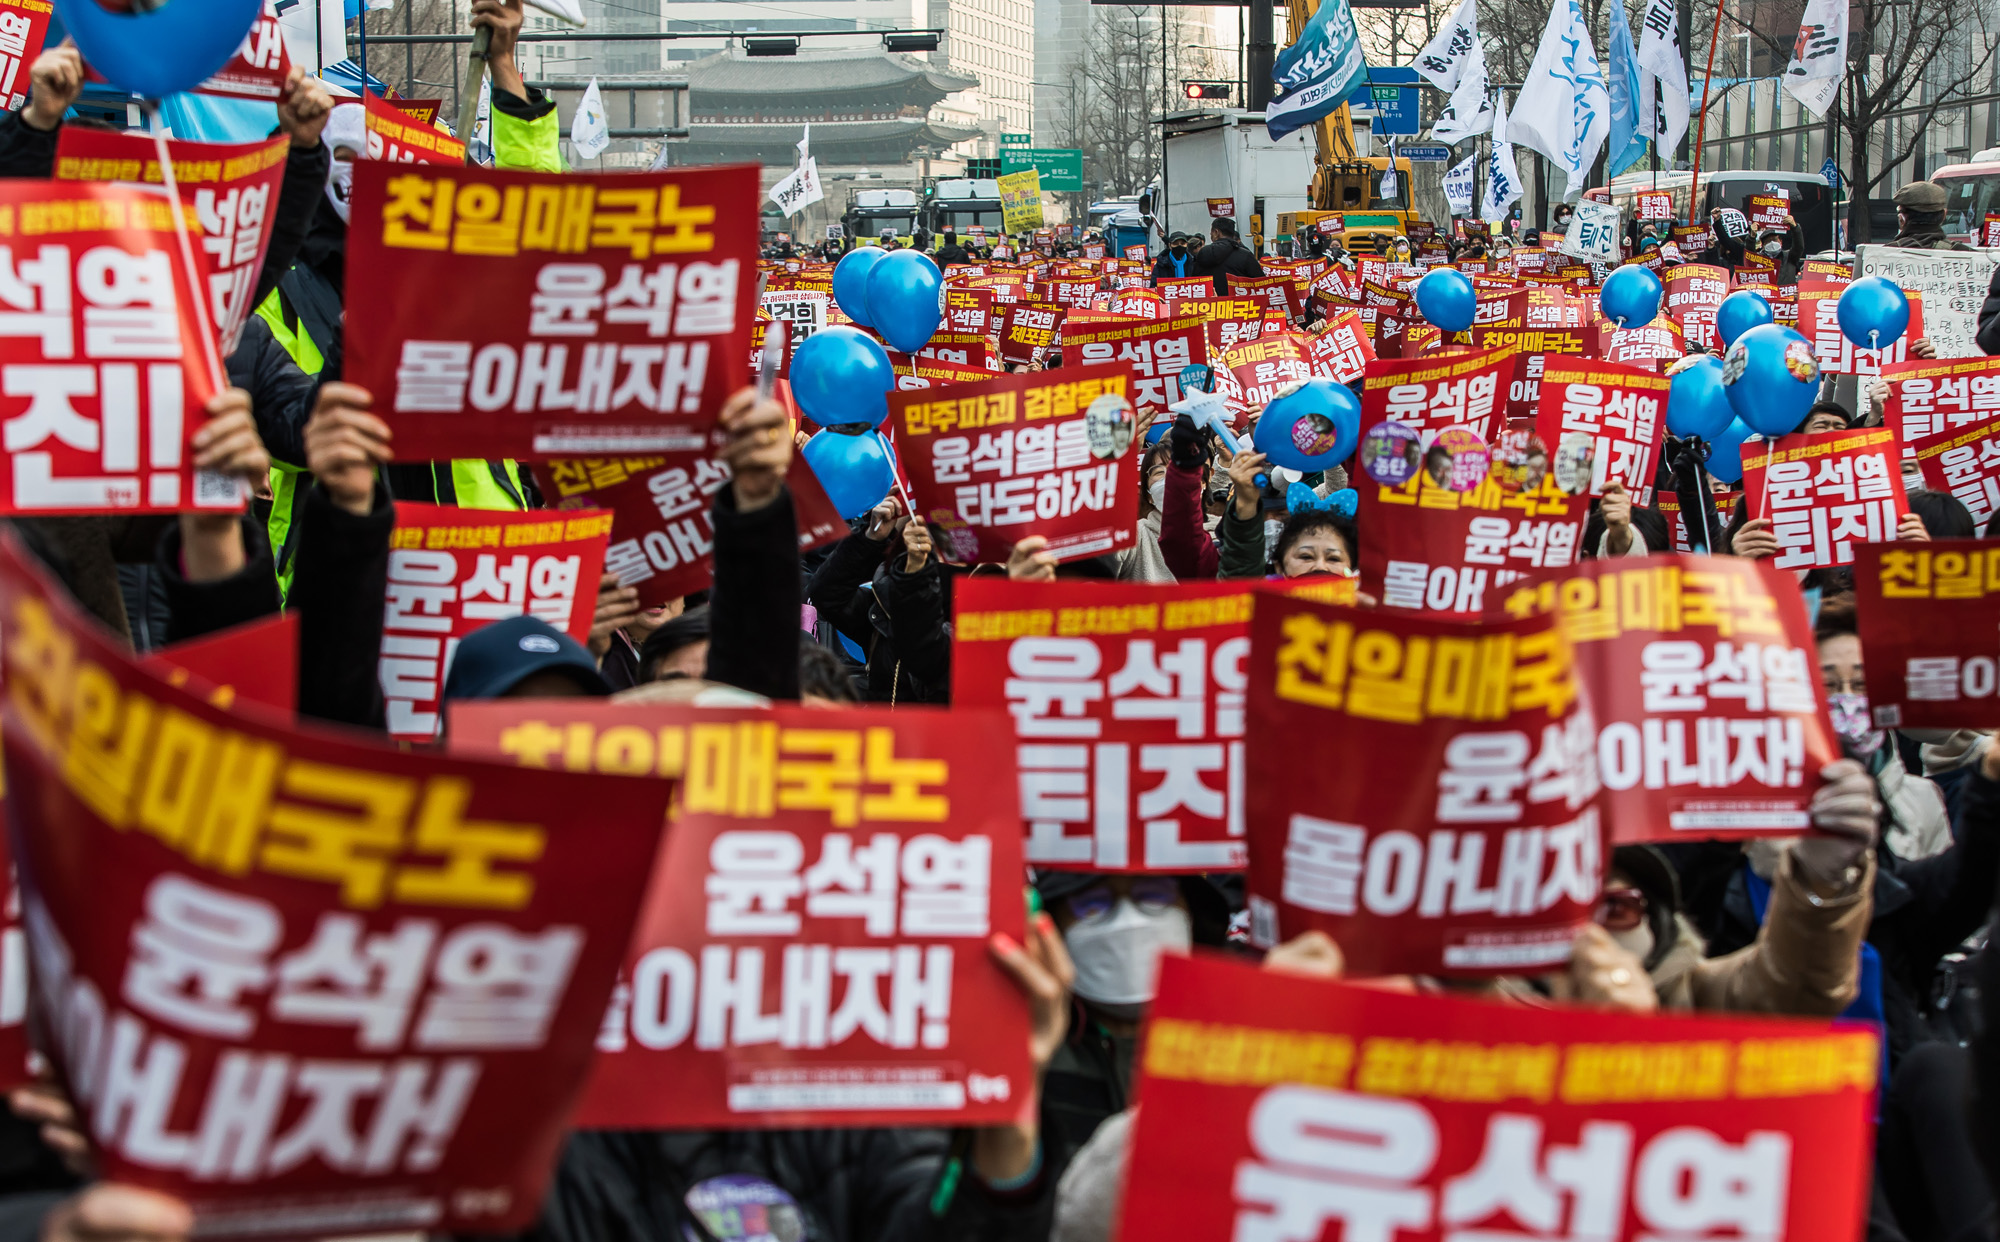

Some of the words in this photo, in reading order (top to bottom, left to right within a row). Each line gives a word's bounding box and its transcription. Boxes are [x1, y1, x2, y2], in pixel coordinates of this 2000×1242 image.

[195, 182, 271, 269] 석열
[381, 174, 716, 260] 친일매국노
[1722, 212, 1743, 223] 건희
[794, 280, 833, 294] 친일매
[1058, 282, 1096, 298] 윤석열
[1164, 284, 1206, 299] 윤석열
[1562, 270, 1590, 278] 친일매국
[1666, 266, 1721, 283] 친일매국노
[1690, 278, 1726, 295] 윤석열
[1808, 262, 1852, 278] 친일매국노
[0, 243, 184, 360] 석열
[528, 258, 740, 338] 윤석열
[1012, 308, 1056, 330] 김건희
[1474, 299, 1508, 324] 건희
[1668, 292, 1722, 308] 몰아내자!
[953, 334, 986, 344] 친일매국
[1062, 333, 1096, 347] 민생파탄
[1097, 329, 1132, 342] 정치보복
[1133, 322, 1170, 338] 평화파괴
[1082, 336, 1191, 378] 윤석열
[1220, 320, 1262, 344] 윤석열
[1227, 338, 1302, 370] 일매국노
[1482, 331, 1584, 354] 친일매국노
[1610, 329, 1674, 348] 윤석열을
[394, 339, 710, 413] 몰아내자!
[1254, 359, 1311, 384] 윤석열
[1364, 372, 1408, 390] 민생파탄
[1409, 364, 1450, 386] 정치보복
[1544, 369, 1585, 386] 민생파탄
[1900, 376, 2000, 413] 윤석열
[904, 391, 1018, 437] 민주파괴
[1384, 370, 1499, 428] 윤석열
[1561, 383, 1659, 444] 윤석열
[2, 362, 184, 510] 진!
[931, 418, 1092, 485] 윤석열을
[1790, 443, 1833, 464] 정치보복
[954, 462, 1120, 528] 타도하자!
[1767, 452, 1894, 510] 윤석열
[1464, 516, 1579, 567] 윤석열
[1771, 499, 1898, 570] 퇴진!
[385, 549, 581, 635] 윤석열
[1274, 611, 1581, 725] 친일매국
[1639, 640, 1818, 714] 윤석열
[1436, 728, 1602, 825] 윤석
[1599, 716, 1805, 791] 아내자!
[1016, 741, 1248, 870] 퇴진
[704, 829, 993, 938] 윤석열
[1280, 812, 1601, 922] 몰아내자
[119, 870, 589, 1052] 윤석열
[594, 942, 955, 1055] 아내자!
[25, 895, 486, 1185] 아내자!
[1232, 1082, 1794, 1242] 윤석열
